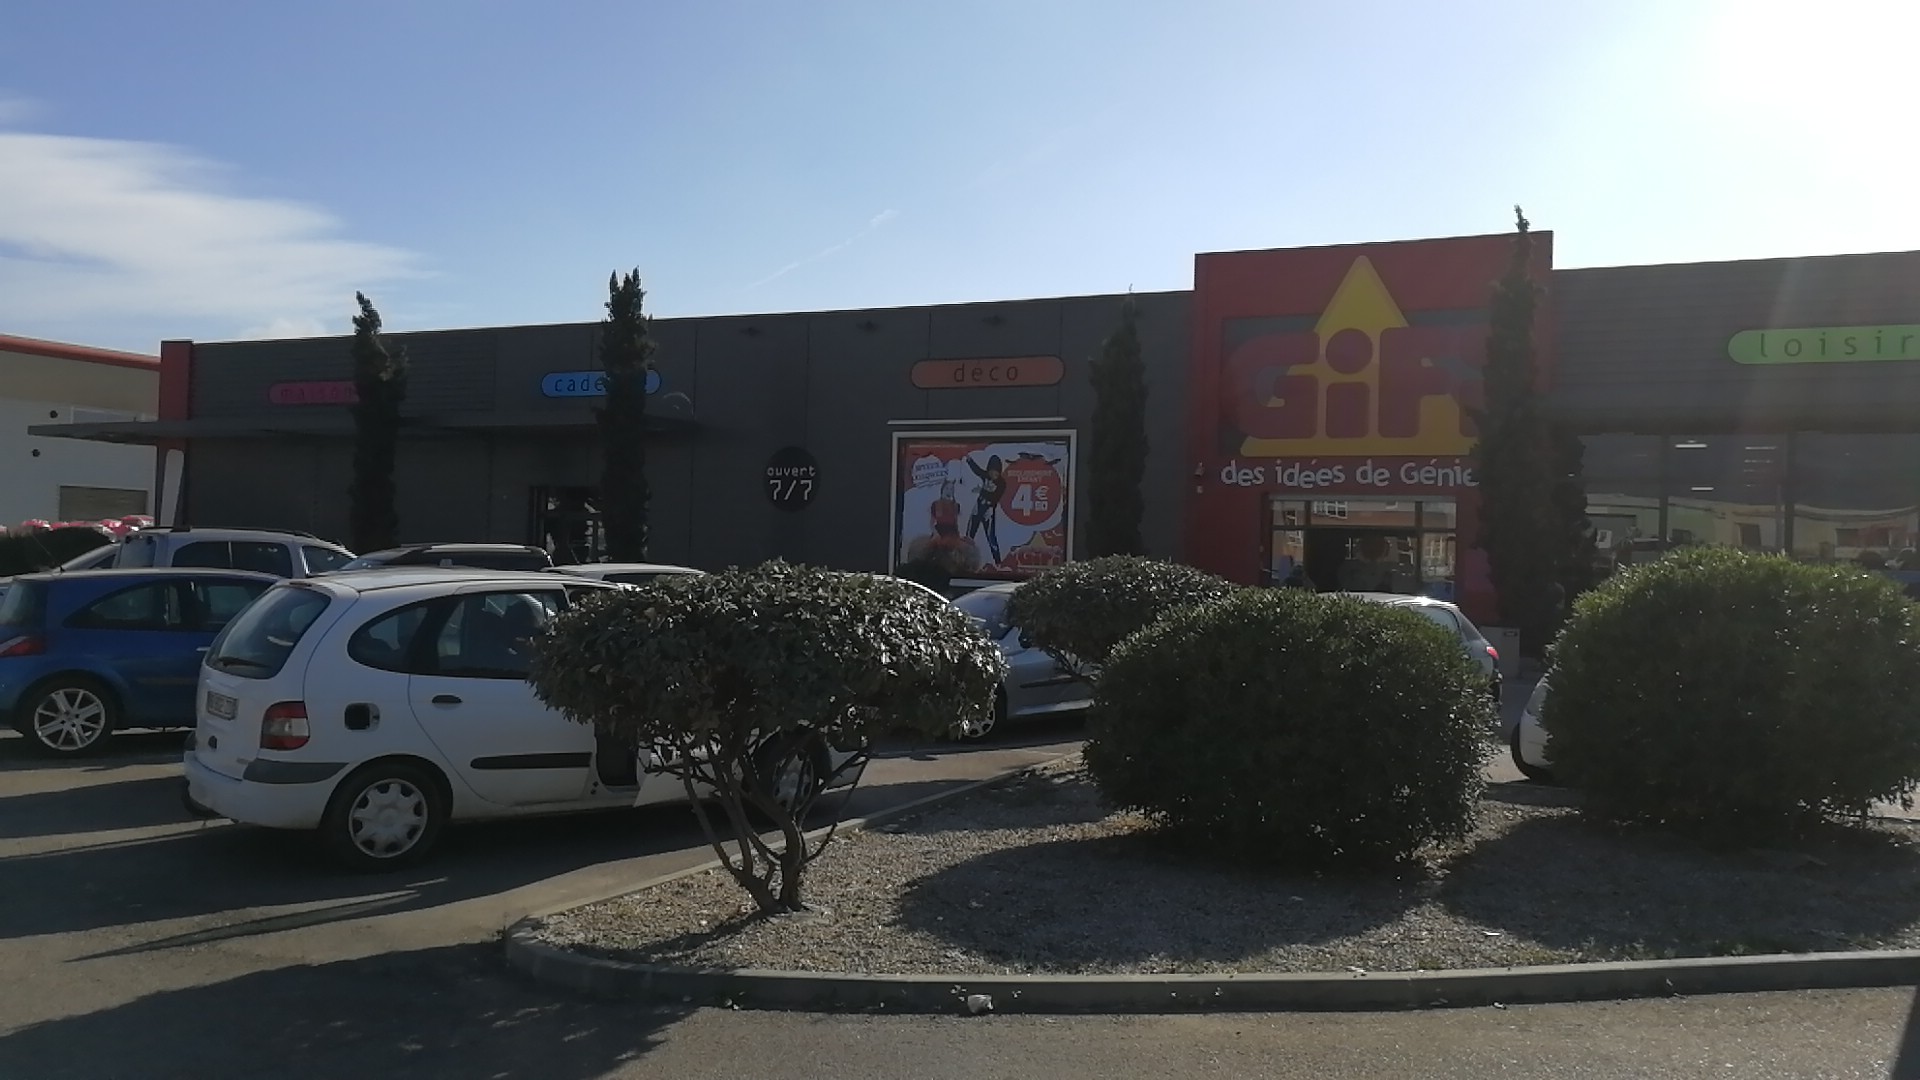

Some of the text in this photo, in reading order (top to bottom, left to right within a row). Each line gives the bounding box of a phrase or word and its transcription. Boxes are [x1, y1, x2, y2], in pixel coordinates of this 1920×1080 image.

[1759, 330, 1915, 358] loisir
[767, 465, 816, 477] ouvert
[1220, 459, 1481, 489] des idées de Génie
[769, 479, 813, 501] 7/7
